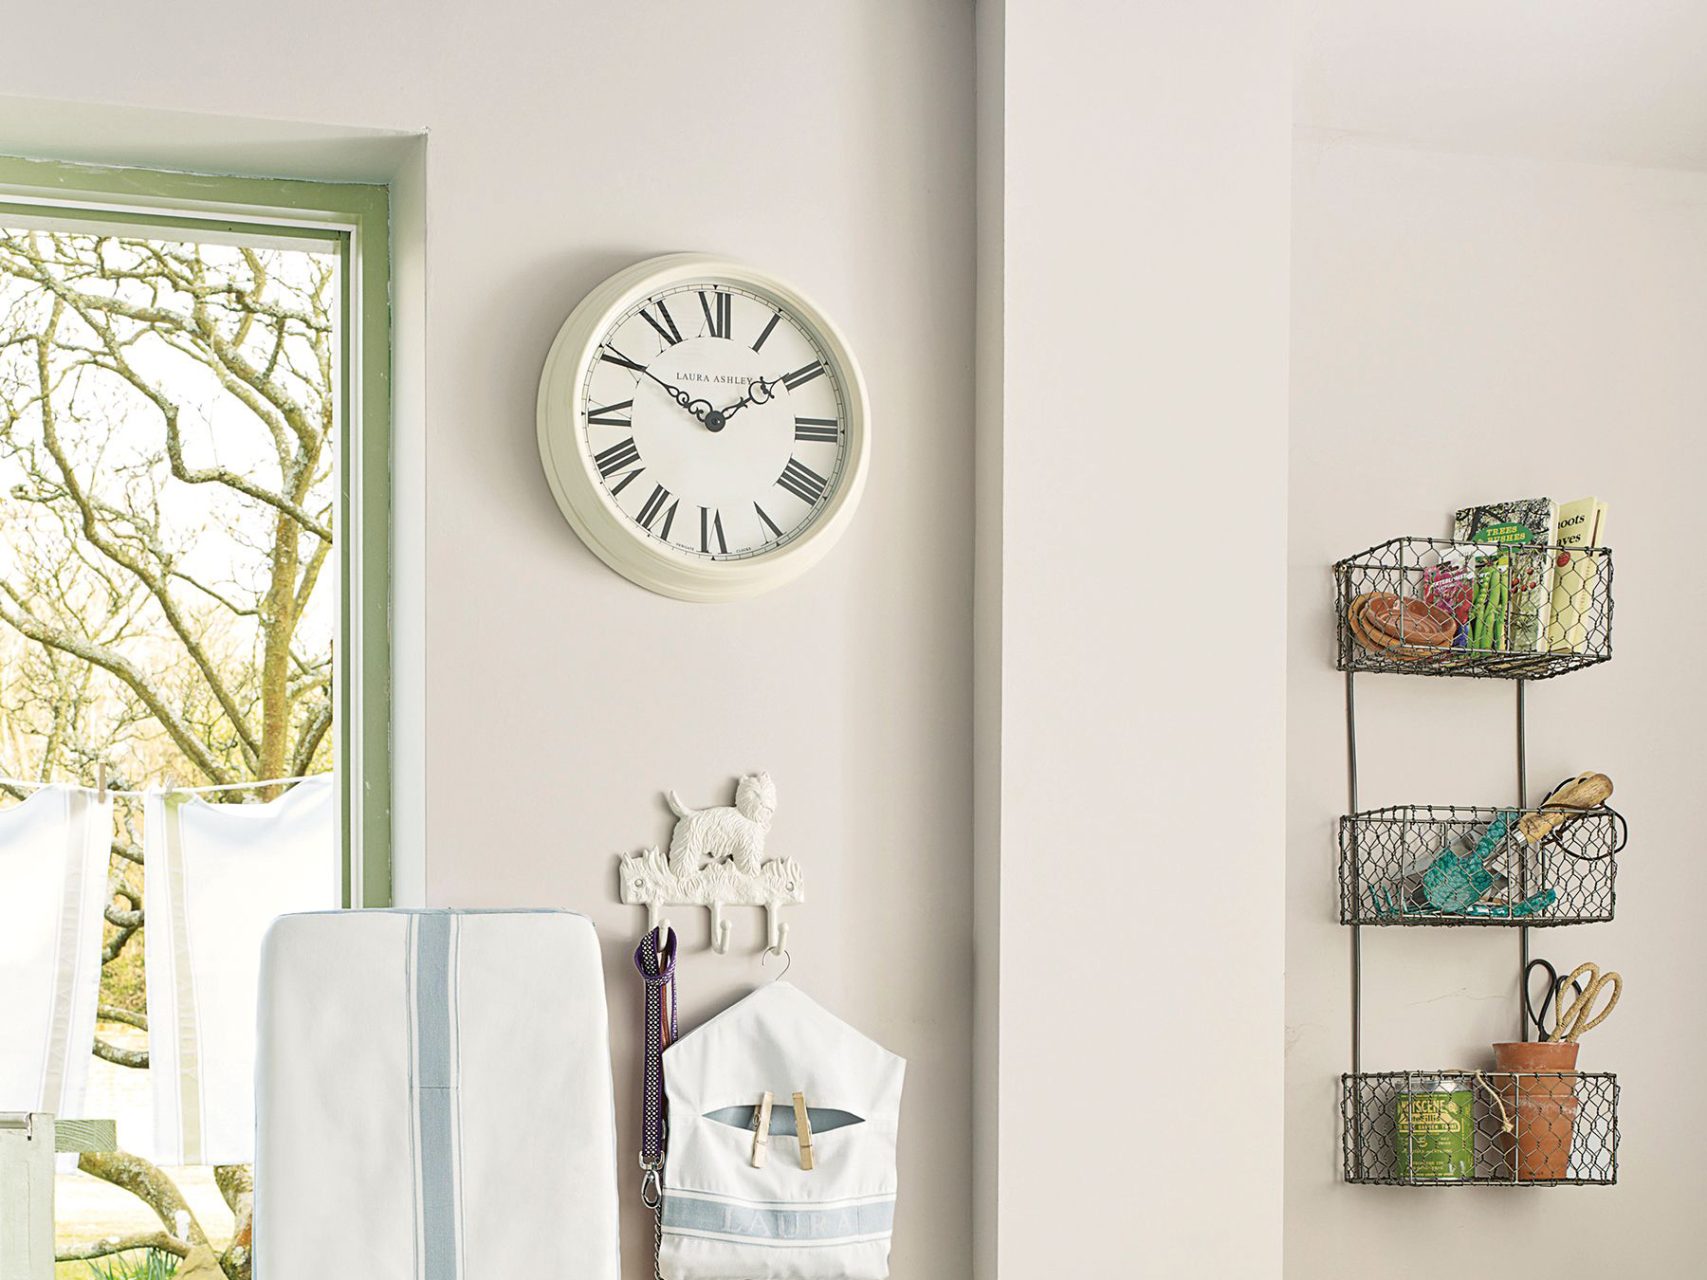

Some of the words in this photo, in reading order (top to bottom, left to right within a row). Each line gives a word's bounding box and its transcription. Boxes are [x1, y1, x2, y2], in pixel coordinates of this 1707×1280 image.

[676, 372, 710, 382] LAURA
[713, 375, 754, 385] ASHLEY
[1487, 525, 1518, 537] TREES
